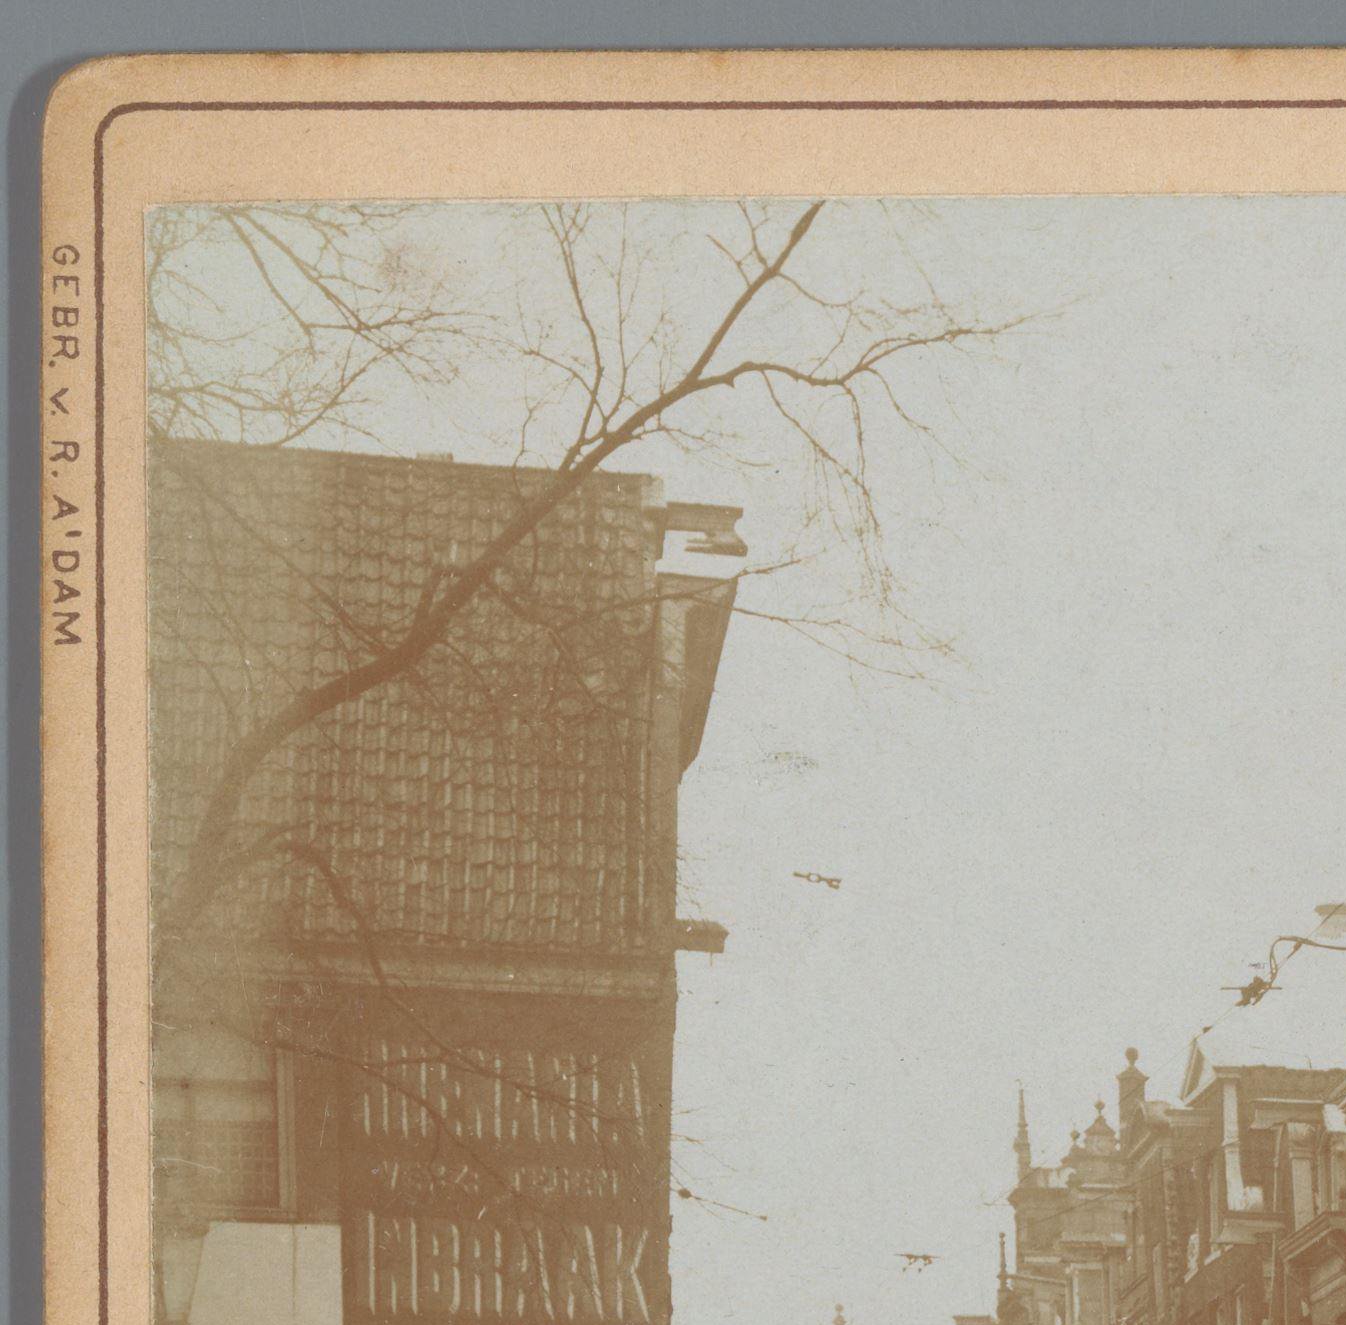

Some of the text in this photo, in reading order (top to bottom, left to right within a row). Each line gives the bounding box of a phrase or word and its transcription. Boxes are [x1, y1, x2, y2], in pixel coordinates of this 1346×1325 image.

[51, 244, 80, 368] GEBR.
[50, 440, 80, 478] R.
[52, 494, 82, 646] A'DAM
